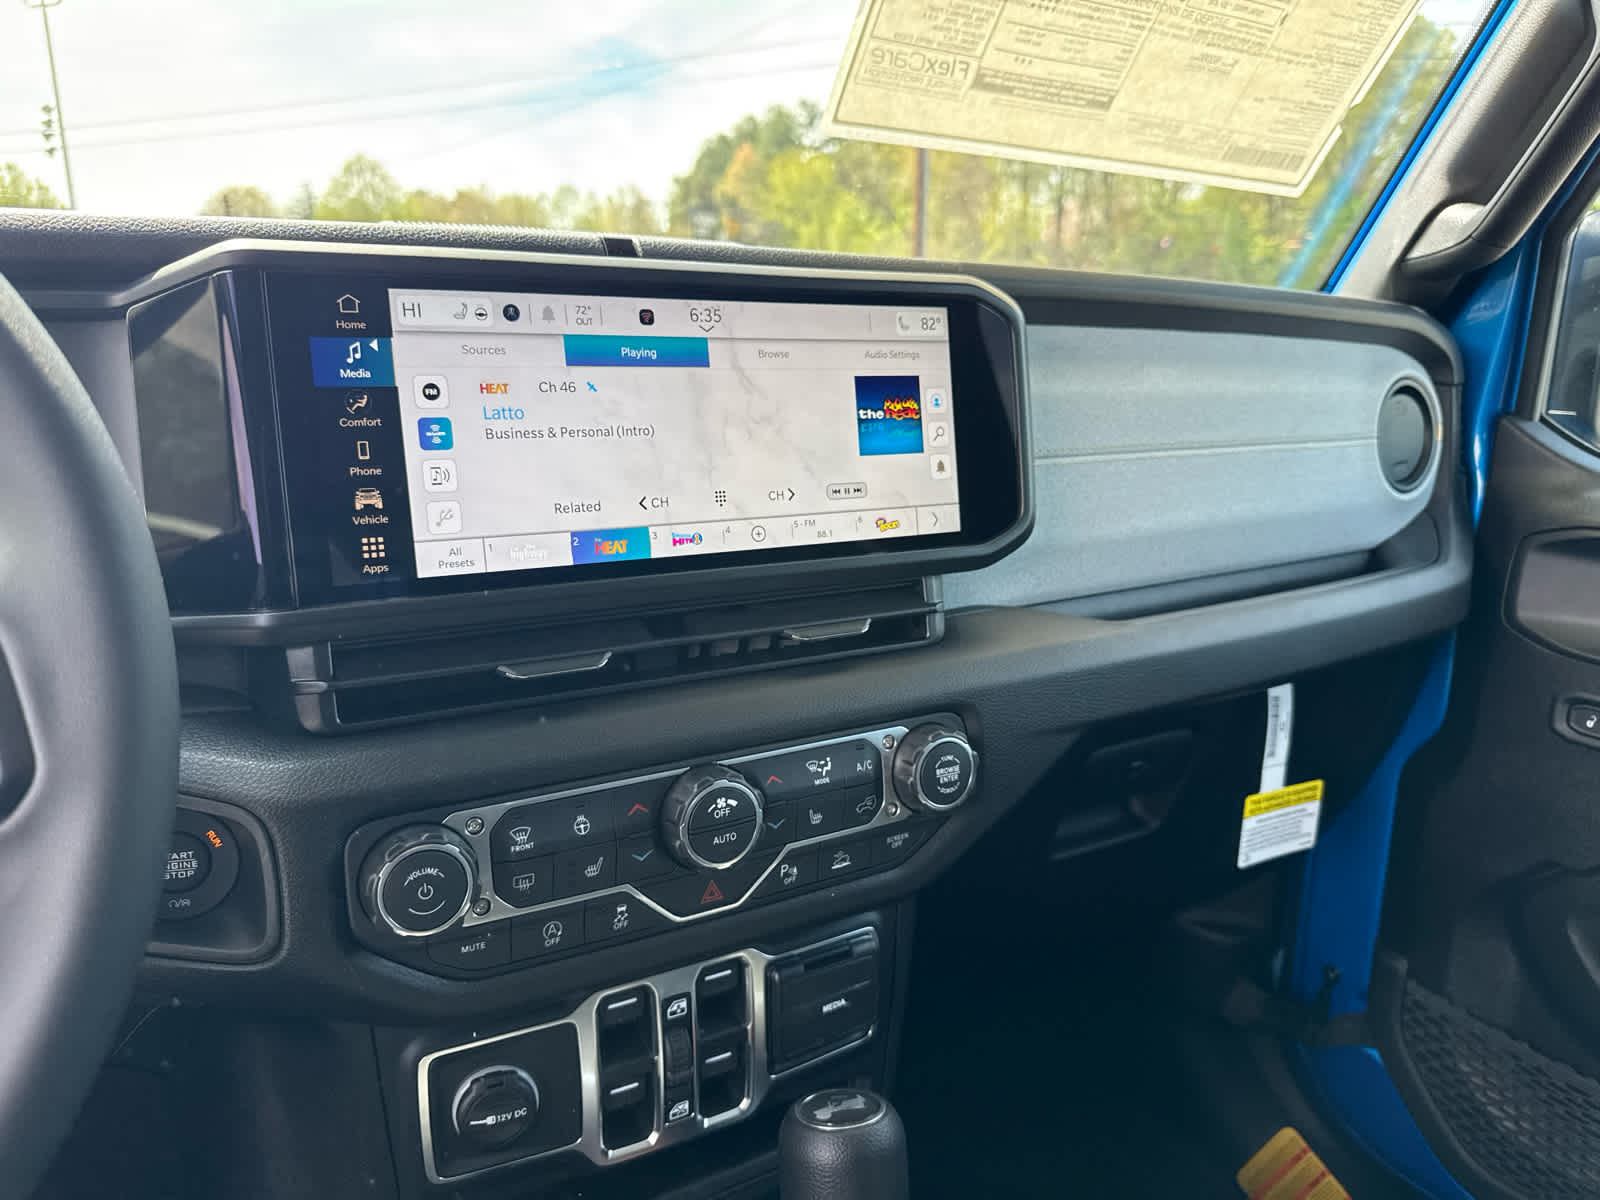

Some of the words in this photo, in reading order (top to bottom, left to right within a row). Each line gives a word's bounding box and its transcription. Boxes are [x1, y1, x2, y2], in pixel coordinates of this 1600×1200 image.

[402, 303, 422, 318] HI
[689, 308, 722, 324] 6:35
[335, 320, 367, 330] Home
[576, 316, 593, 327] OUT
[920, 317, 942, 331] 82°
[461, 344, 507, 356] Sources
[620, 347, 657, 360] Playing
[758, 350, 790, 360] Browse
[864, 350, 887, 360] Audio
[889, 350, 920, 361] Settings
[339, 368, 371, 379] Media
[479, 383, 509, 395] HEAT
[538, 381, 558, 394] Ch
[559, 381, 577, 393] 46
[482, 406, 525, 421] Latto
[858, 409, 884, 419] the
[339, 416, 382, 427] Comfort
[485, 428, 544, 440] Business
[547, 427, 557, 438] &
[560, 425, 614, 438] Personal
[616, 425, 656, 439] (Intro)
[349, 466, 382, 476] Phone
[768, 491, 785, 501] CH
[554, 501, 601, 514] Related
[651, 497, 670, 509] CH
[352, 514, 389, 525] Vehicle
[573, 536, 580, 546] 2
[448, 546, 463, 557] All
[594, 540, 628, 556] HEAT
[362, 563, 390, 575] Apps
[438, 558, 475, 570] Presets
[856, 760, 873, 772] A/C
[814, 777, 830, 785] MODE
[714, 808, 731, 819] OFF
[206, 830, 223, 848] RUN
[713, 832, 737, 846] AUTO
[510, 841, 535, 853] FRONT
[167, 850, 194, 860] ART
[167, 860, 199, 870] GINE
[408, 867, 440, 880] VOLUME
[613, 919, 629, 930] OFF
[461, 941, 487, 954] MUTE
[544, 936, 561, 947] OFF
[822, 998, 846, 1012] MEDIA
[497, 1111, 513, 1122] 12V
[514, 1107, 528, 1118] DC
